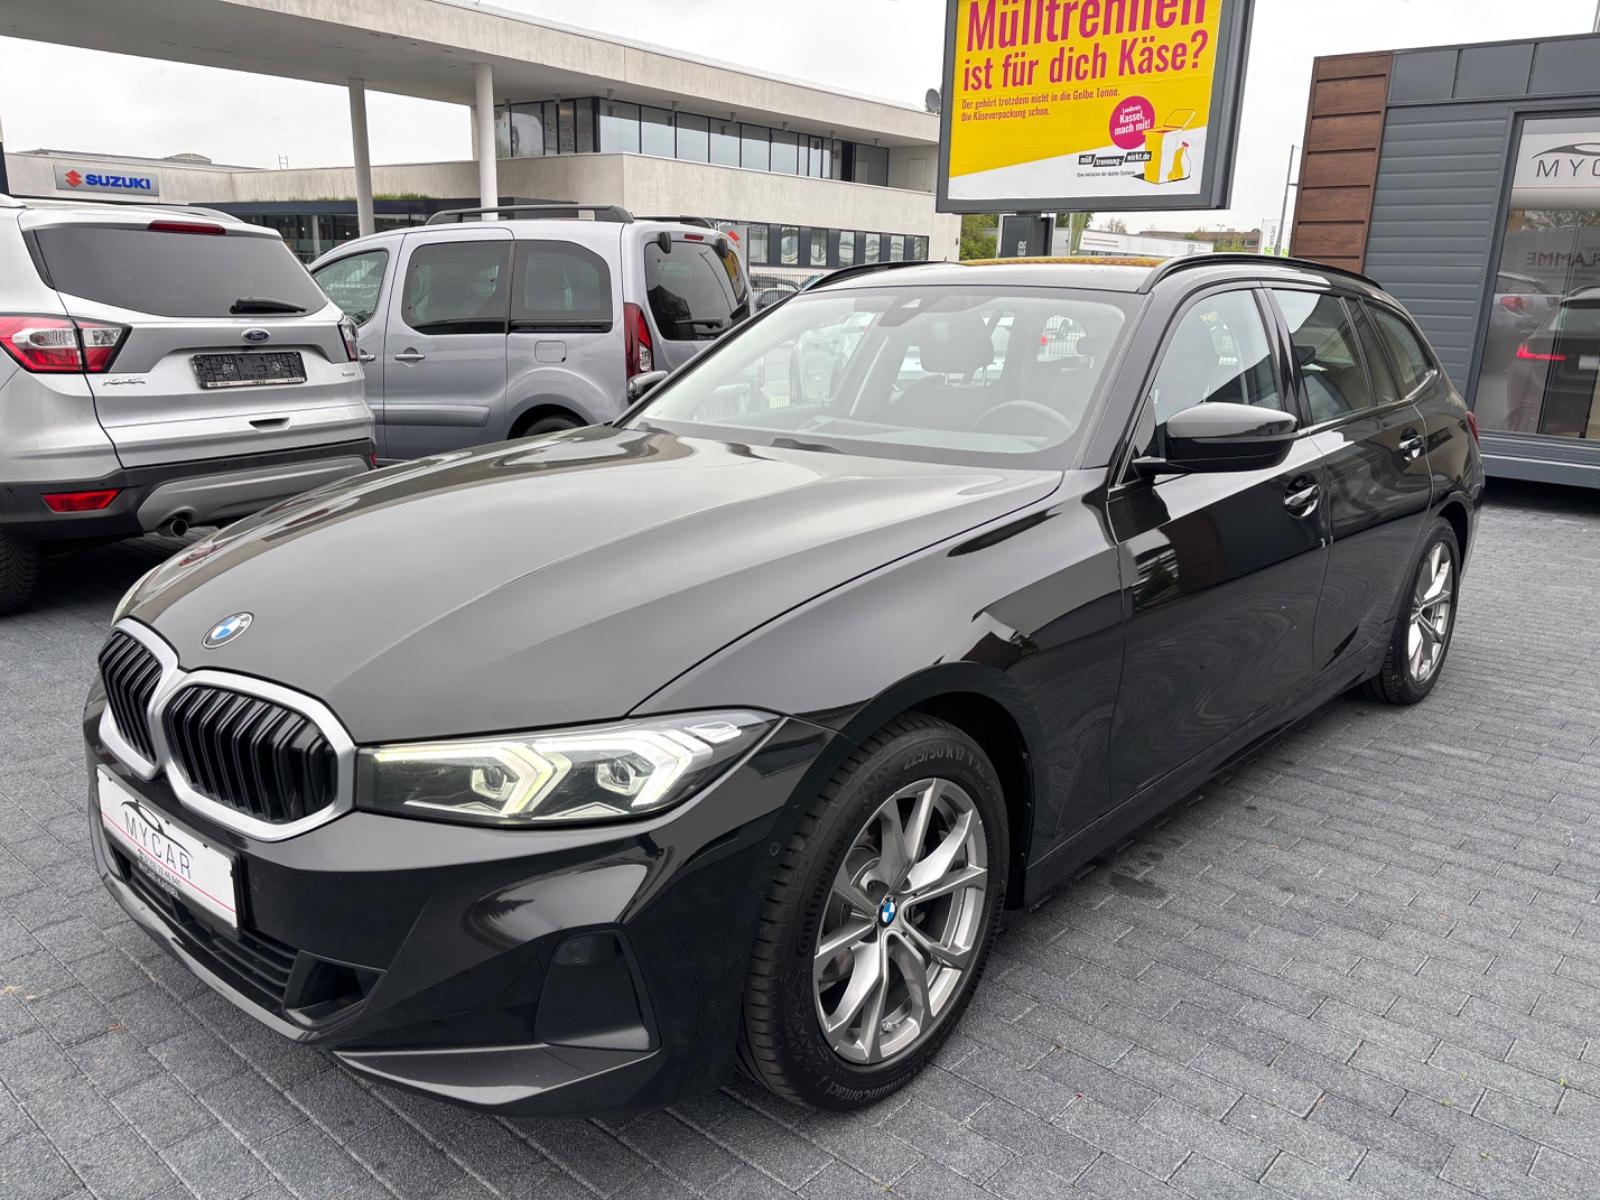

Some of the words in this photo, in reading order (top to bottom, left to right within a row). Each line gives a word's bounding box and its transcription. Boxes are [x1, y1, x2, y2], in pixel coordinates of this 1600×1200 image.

[966, 0, 1206, 52] Mülltrennen
[963, 56, 993, 92] ist
[1002, 51, 1039, 88] für
[1049, 42, 1108, 84] dich
[1118, 29, 1209, 77] Käse?
[961, 100, 973, 109] Der
[975, 97, 997, 111] gehört
[998, 95, 1029, 108] trotzdem
[1031, 93, 1049, 104] nicht
[1059, 90, 1071, 101] die
[1073, 89, 1094, 101] Gelbe
[1096, 88, 1120, 98] Tonne.
[961, 111, 972, 122] Die
[973, 108, 1027, 121] Käseverpackung
[1028, 106, 1050, 117] schon.
[1119, 110, 1145, 124] Kassel,
[1114, 124, 1134, 136] mach
[1135, 119, 1151, 132] mit!
[85, 174, 151, 189] SUZUKI
[903, 746, 944, 770] 225/50
[124, 811, 192, 880] MYCAR
